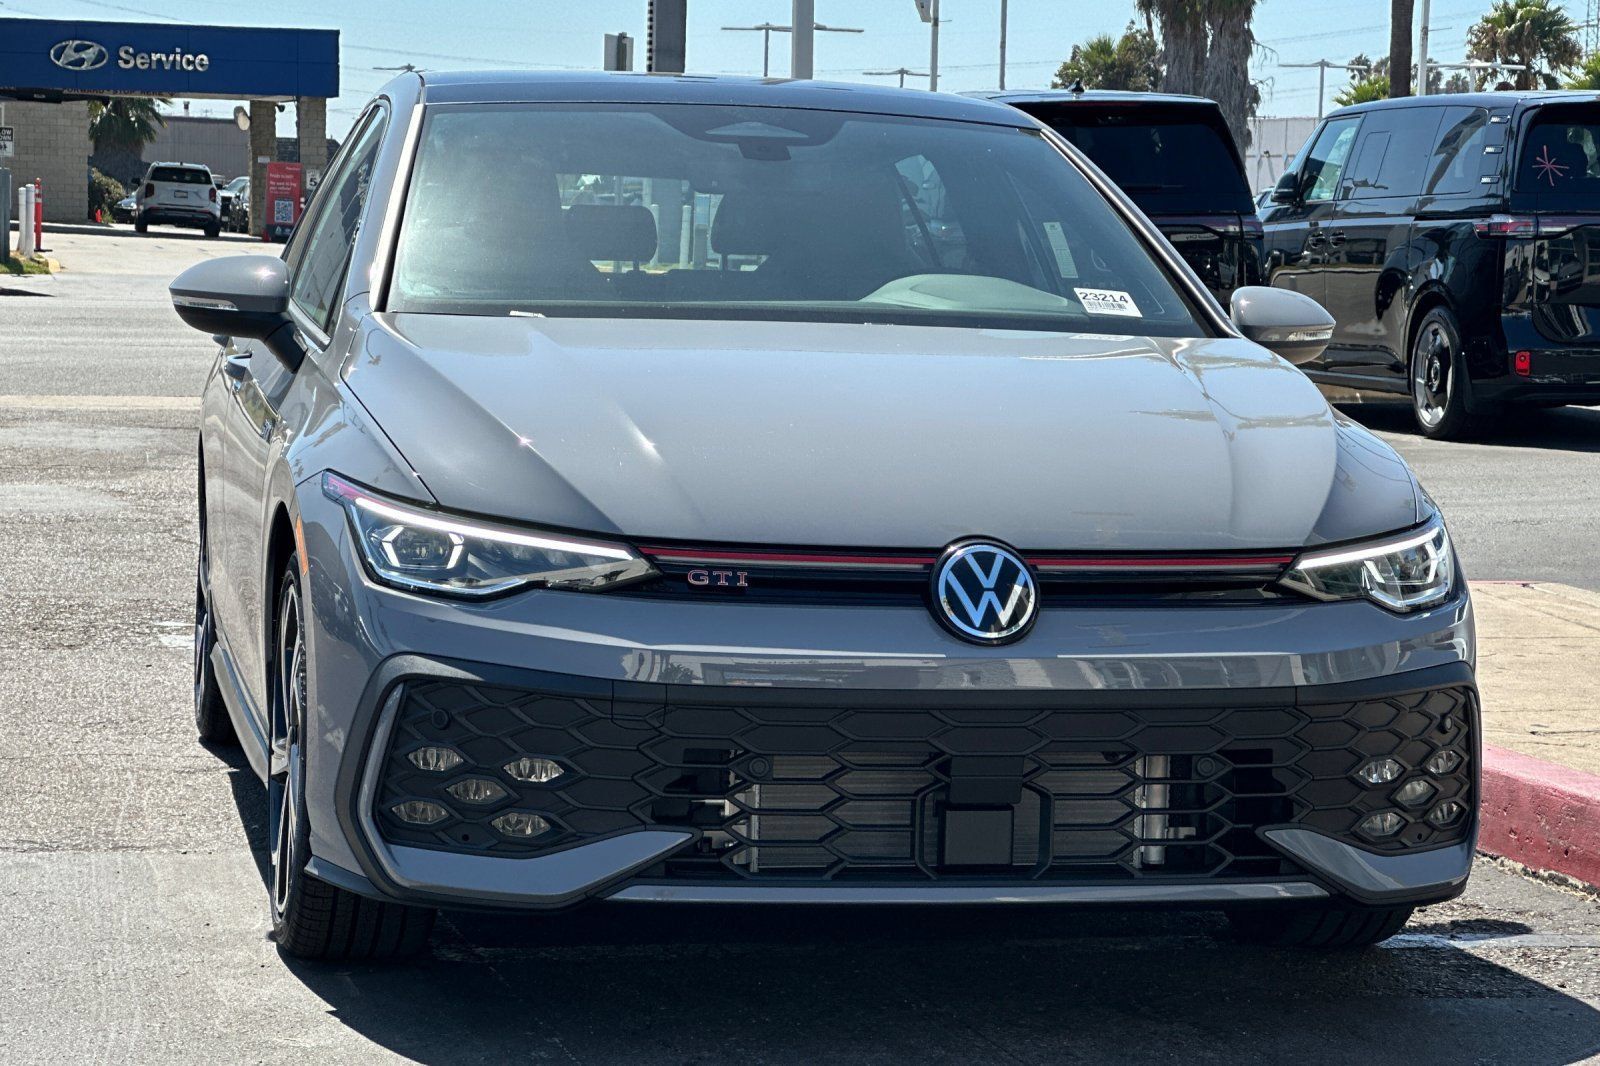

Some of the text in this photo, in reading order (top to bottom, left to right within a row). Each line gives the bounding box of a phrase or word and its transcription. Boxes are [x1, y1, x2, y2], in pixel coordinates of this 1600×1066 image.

[117, 46, 210, 72] Service
[1079, 291, 1129, 304] 23214
[687, 569, 750, 588] GTI
